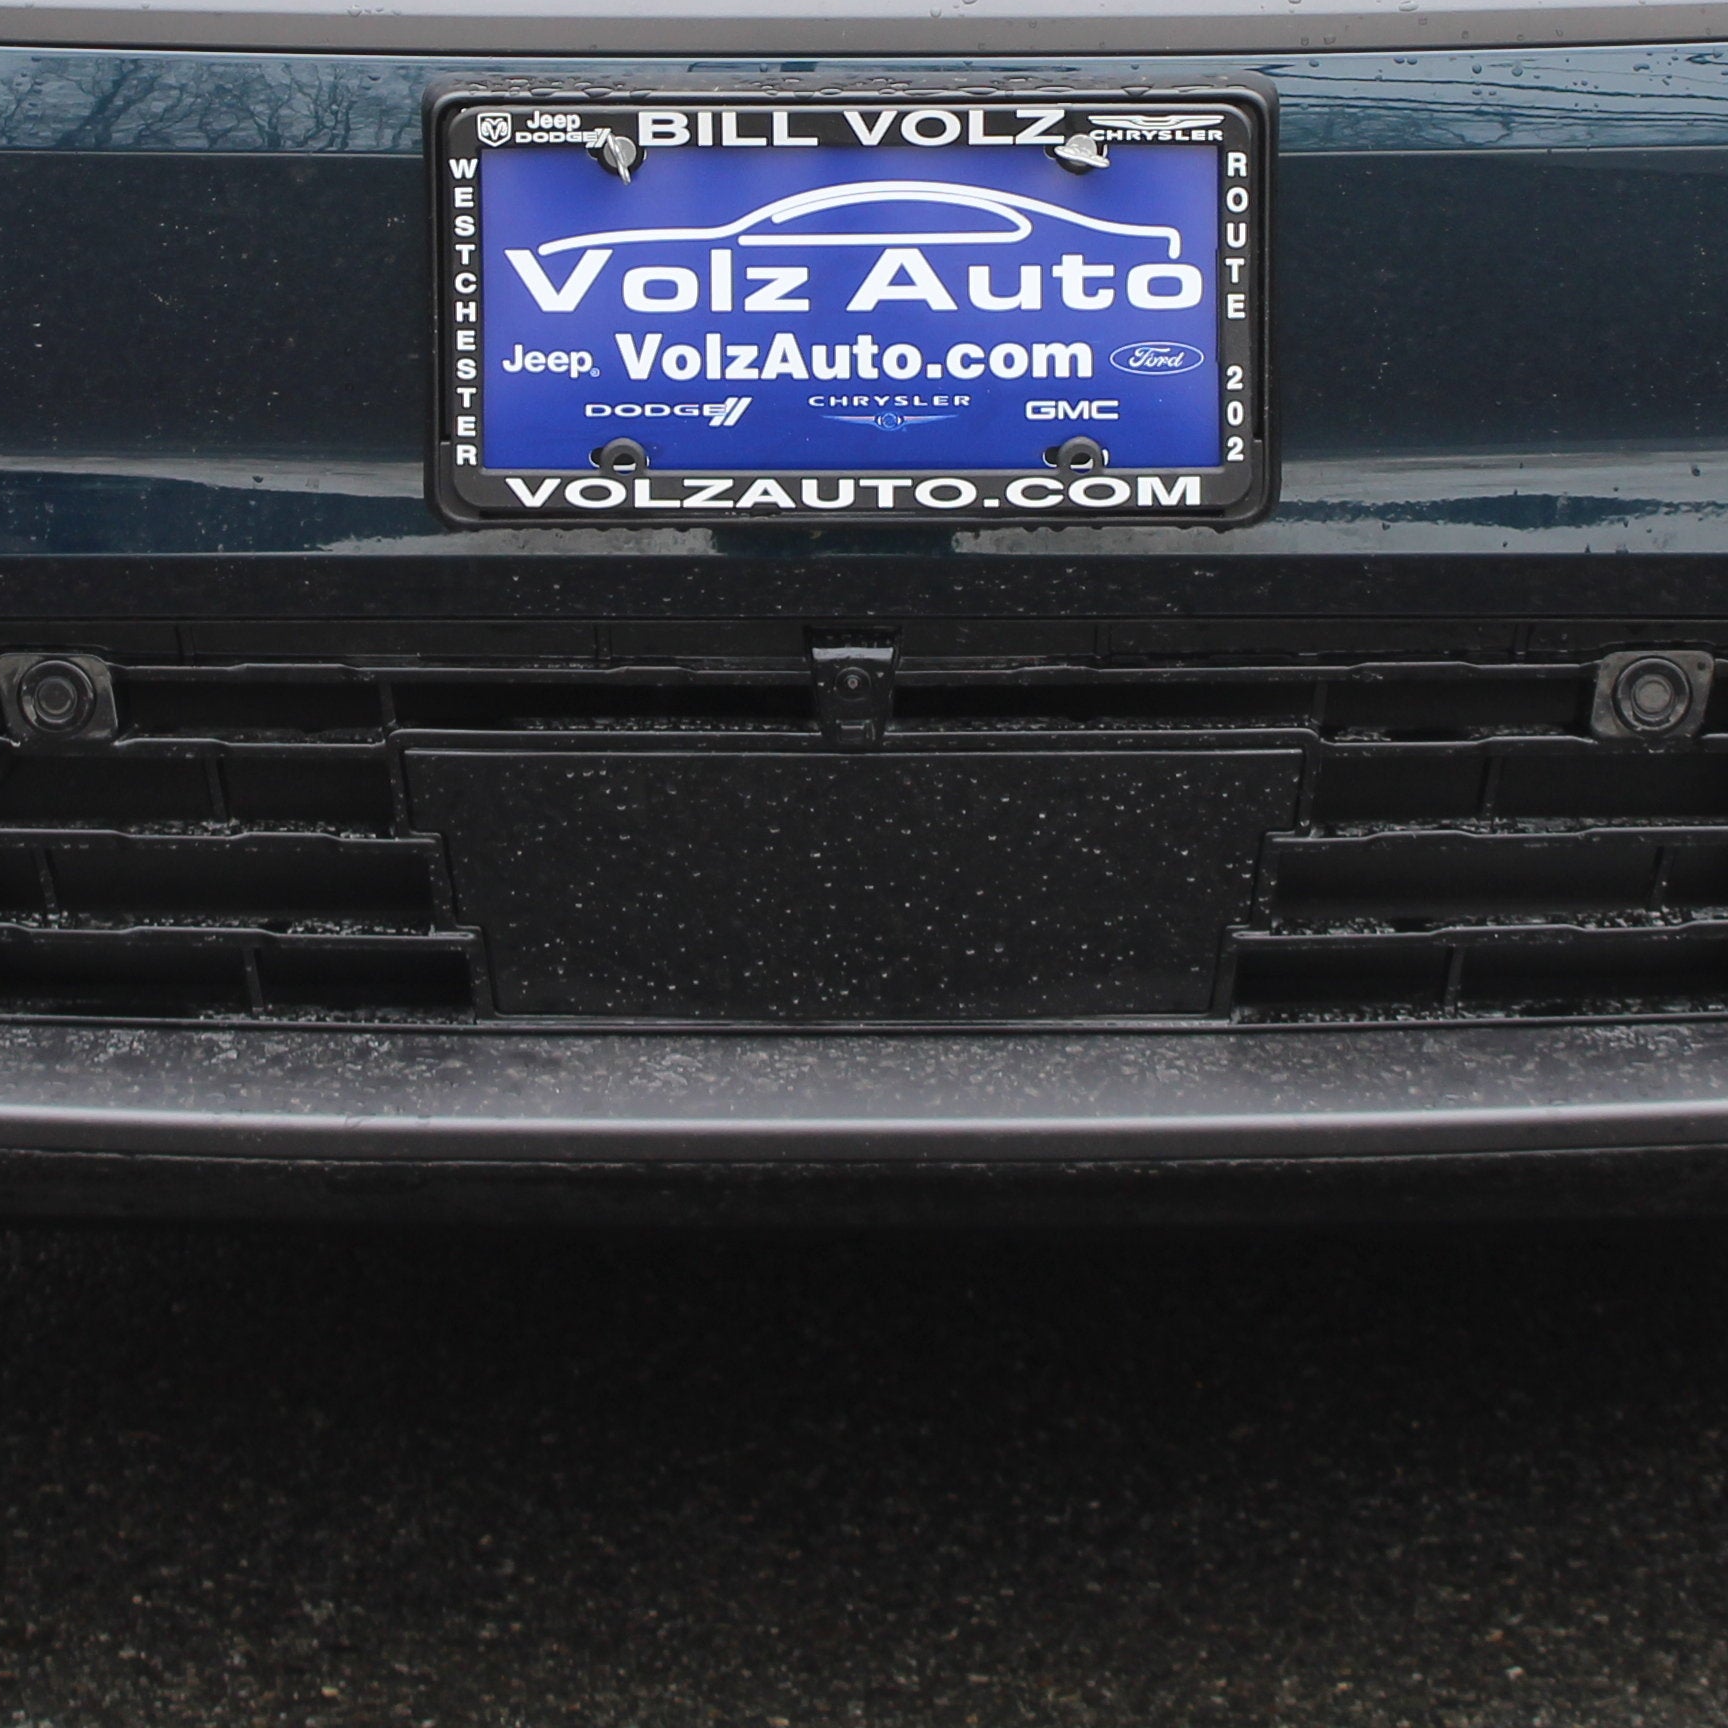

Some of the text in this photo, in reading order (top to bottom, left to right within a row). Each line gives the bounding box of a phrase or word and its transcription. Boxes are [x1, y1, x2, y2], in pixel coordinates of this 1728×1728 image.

[526, 110, 582, 131] Jeep
[637, 108, 1068, 147] BILL VOLZ
[515, 131, 600, 144] DODGE
[1089, 129, 1225, 142] CHRYSLER
[505, 247, 1204, 313] Volz Auto
[449, 158, 478, 466] WESTCHESTER
[1225, 151, 1249, 462] ROUTE 202
[502, 344, 594, 379] Jeep
[615, 332, 1094, 381] VolzAuto.com
[1128, 345, 1185, 369] Ford
[584, 403, 726, 418] DODGE
[808, 394, 971, 408] CHRYSLER
[1025, 399, 1120, 421] GMC
[505, 477, 1203, 510] VOLZAUTO.COM
